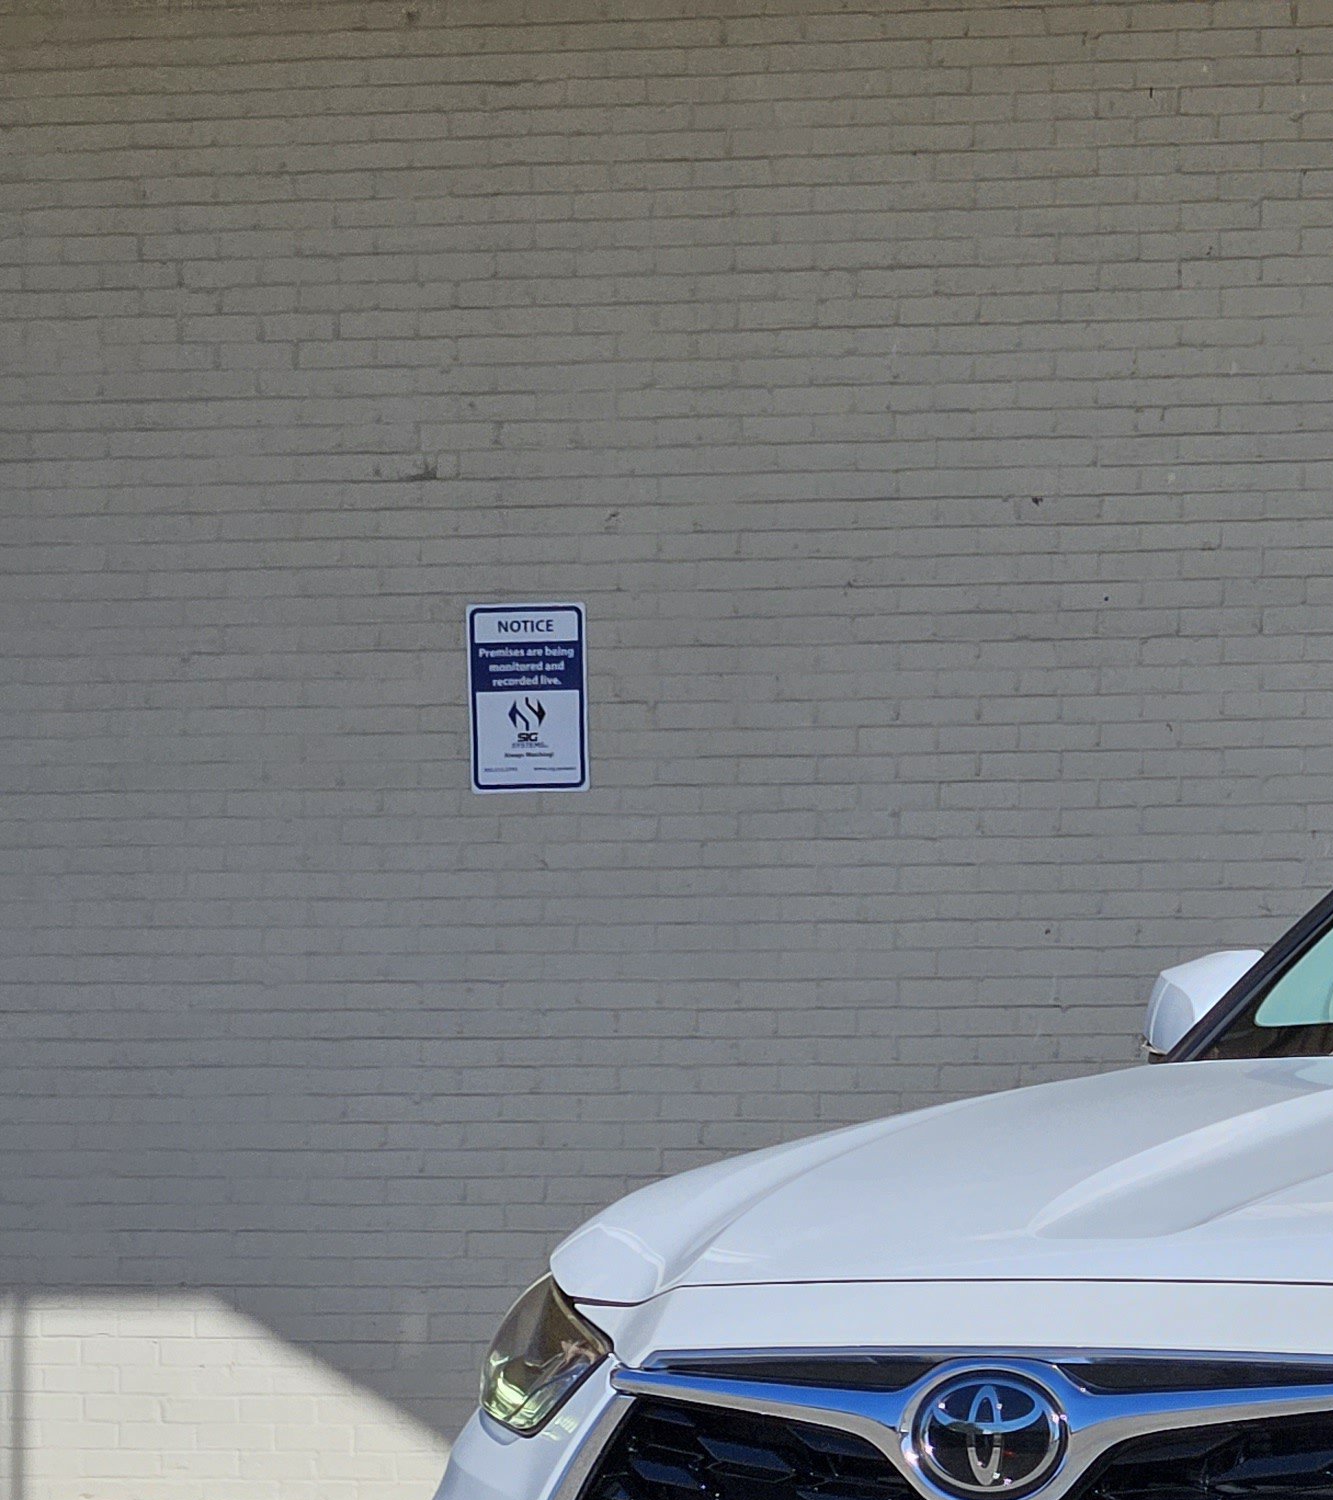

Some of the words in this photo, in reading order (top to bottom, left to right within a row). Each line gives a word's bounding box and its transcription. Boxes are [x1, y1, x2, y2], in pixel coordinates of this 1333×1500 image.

[497, 619, 554, 632] NOTICE
[478, 647, 525, 658] Premises
[526, 648, 543, 657] are
[544, 646, 575, 659] being
[488, 661, 543, 672] monitored
[545, 660, 565, 671] and
[492, 675, 539, 687] recorded
[540, 675, 562, 686] live.
[517, 732, 538, 742] SIG
